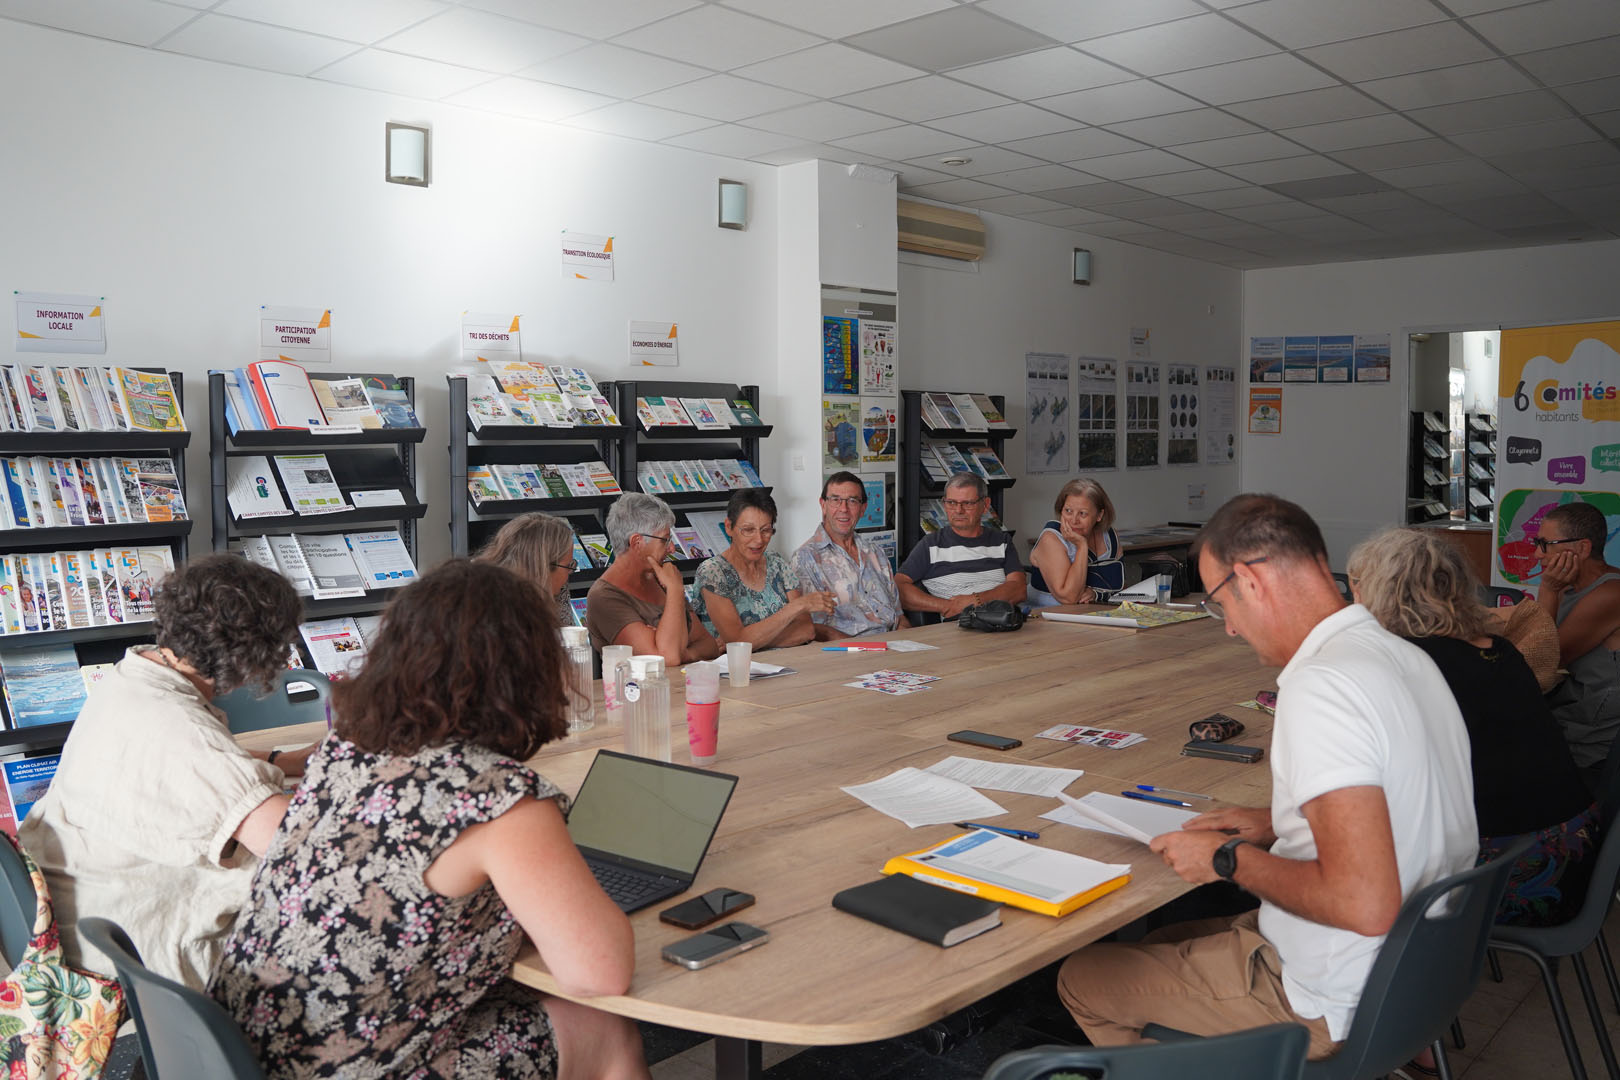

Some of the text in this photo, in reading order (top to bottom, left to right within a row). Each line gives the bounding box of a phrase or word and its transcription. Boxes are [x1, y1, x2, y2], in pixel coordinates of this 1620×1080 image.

[562, 249, 586, 257] TRANSITION
[36, 310, 84, 320] INFORMATION
[48, 322, 73, 331] LOCALE
[275, 325, 317, 335] PARTICIPATION
[280, 336, 311, 345] CITOYENNE
[469, 332, 478, 340] TRI
[488, 332, 510, 341] DÉCHETS
[632, 340, 653, 348] ÉCONOMIES
[1514, 381, 1530, 412] 6
[1535, 412, 1580, 422] habitants
[1559, 462, 1574, 470] Vivre
[1554, 470, 1579, 479] ensemble
